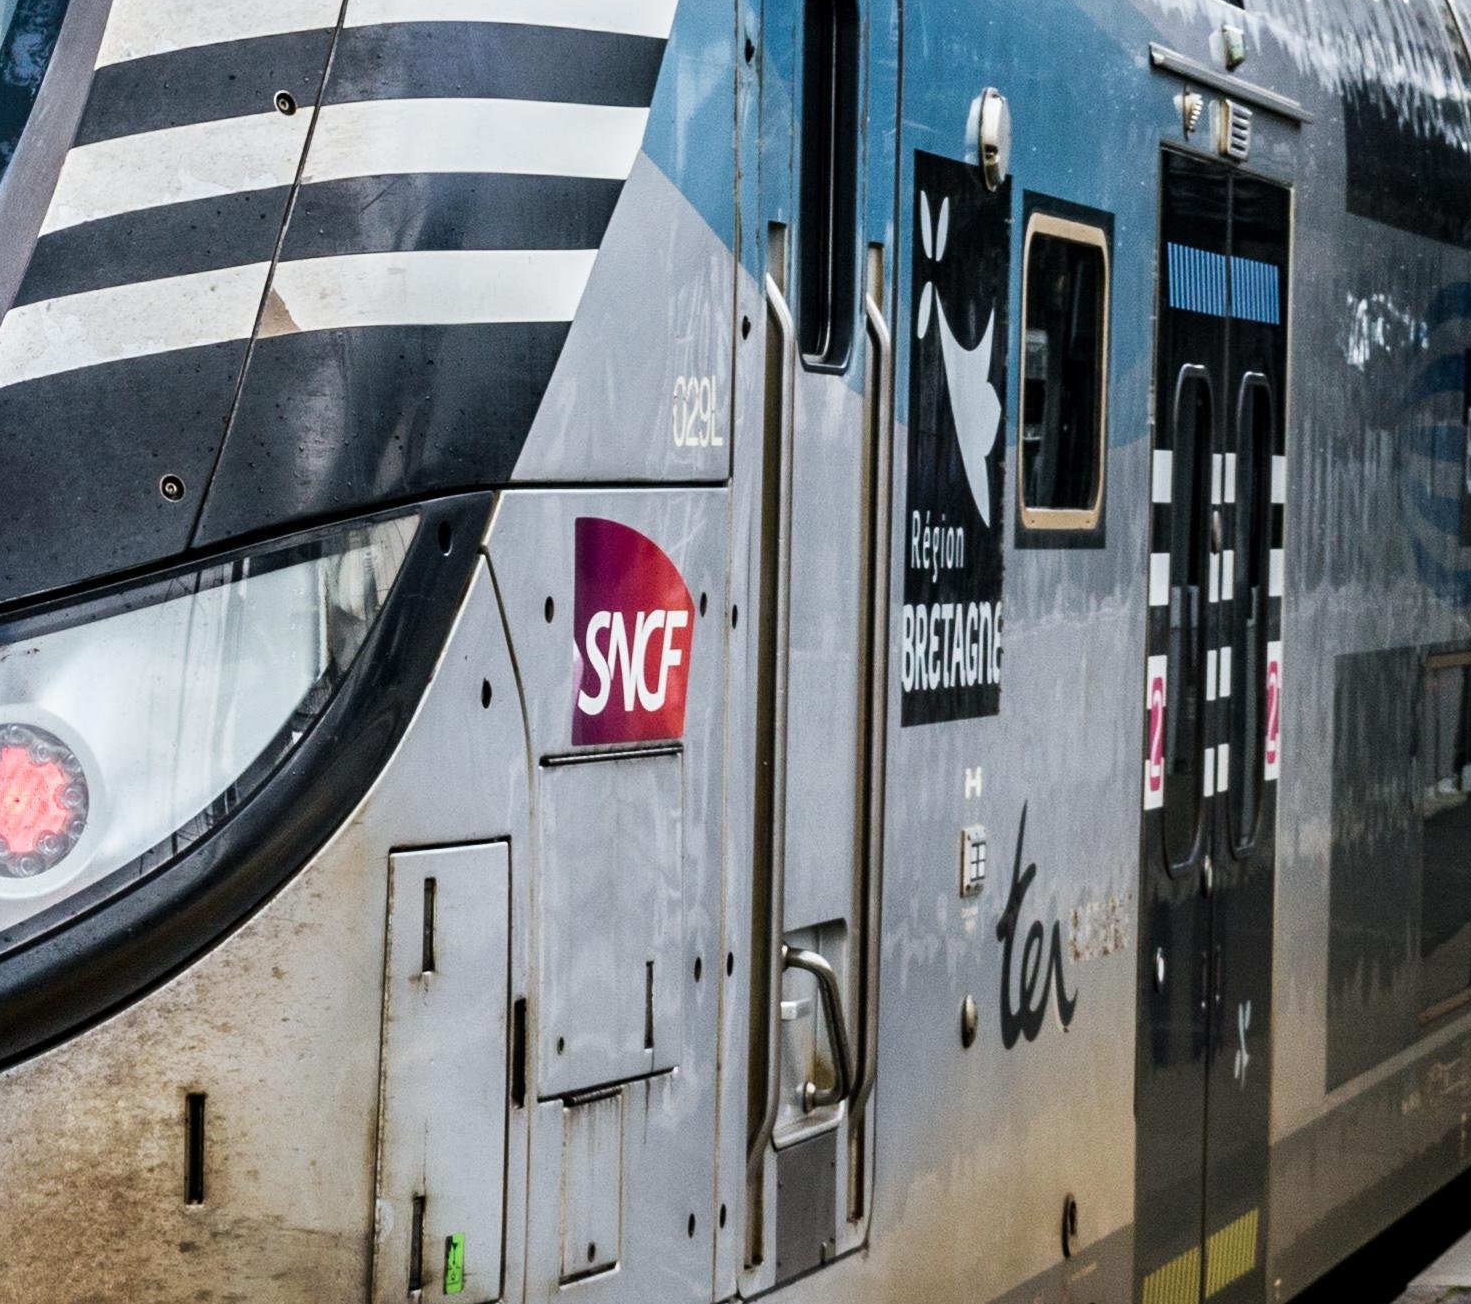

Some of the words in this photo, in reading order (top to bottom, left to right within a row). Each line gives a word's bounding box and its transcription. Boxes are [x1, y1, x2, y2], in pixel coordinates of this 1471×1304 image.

[672, 375, 724, 447] 029L
[911, 510, 964, 583] Région
[577, 609, 689, 715] SNCF
[901, 601, 1002, 693] BRETAGNE
[996, 799, 1078, 1050] ter
